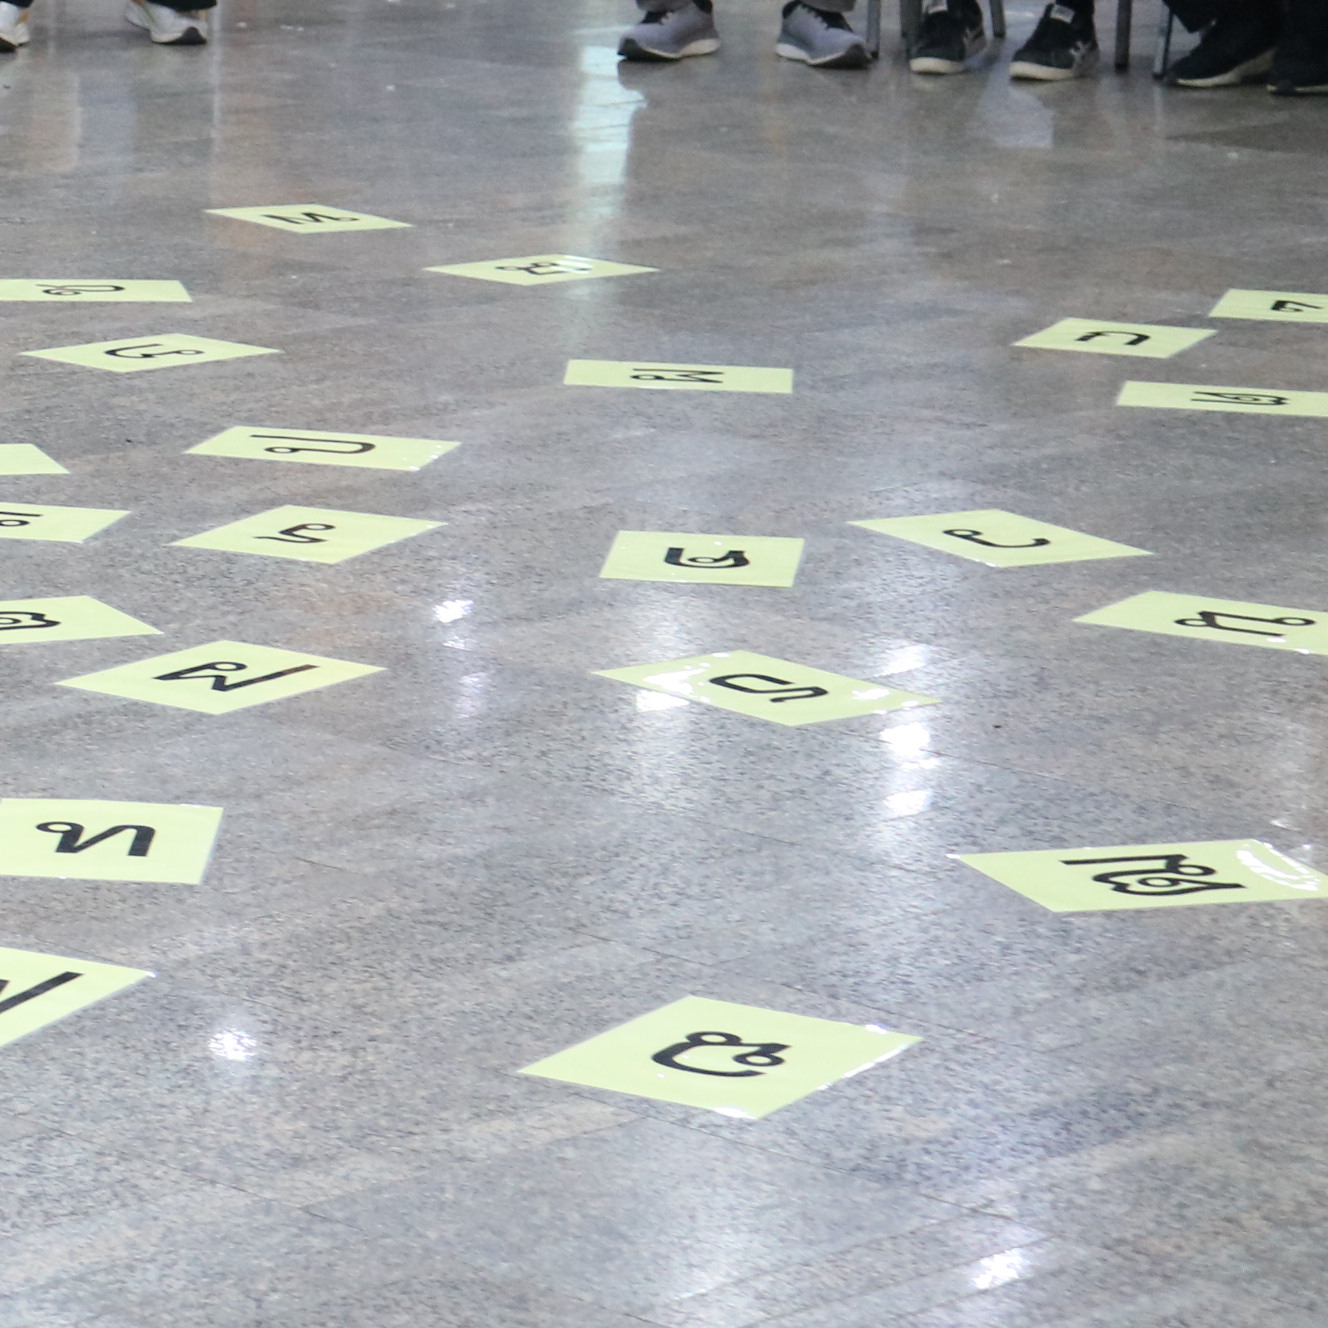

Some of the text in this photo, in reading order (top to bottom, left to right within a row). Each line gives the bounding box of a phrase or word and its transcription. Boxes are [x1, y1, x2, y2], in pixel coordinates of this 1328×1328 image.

[262, 211, 360, 225] พ
[1074, 330, 1152, 347] ก
[103, 343, 205, 359] ภ
[629, 368, 725, 384] ผ
[249, 434, 376, 455] ป
[253, 522, 337, 544] ร
[941, 528, 1052, 549] ว
[663, 546, 751, 570] ค
[1173, 610, 1317, 638] น
[151, 660, 320, 693] ฝ
[708, 673, 830, 704] ธ
[35, 820, 157, 858] ท
[1059, 853, 1247, 897] ฒ
[650, 1030, 792, 1078] ฉ
